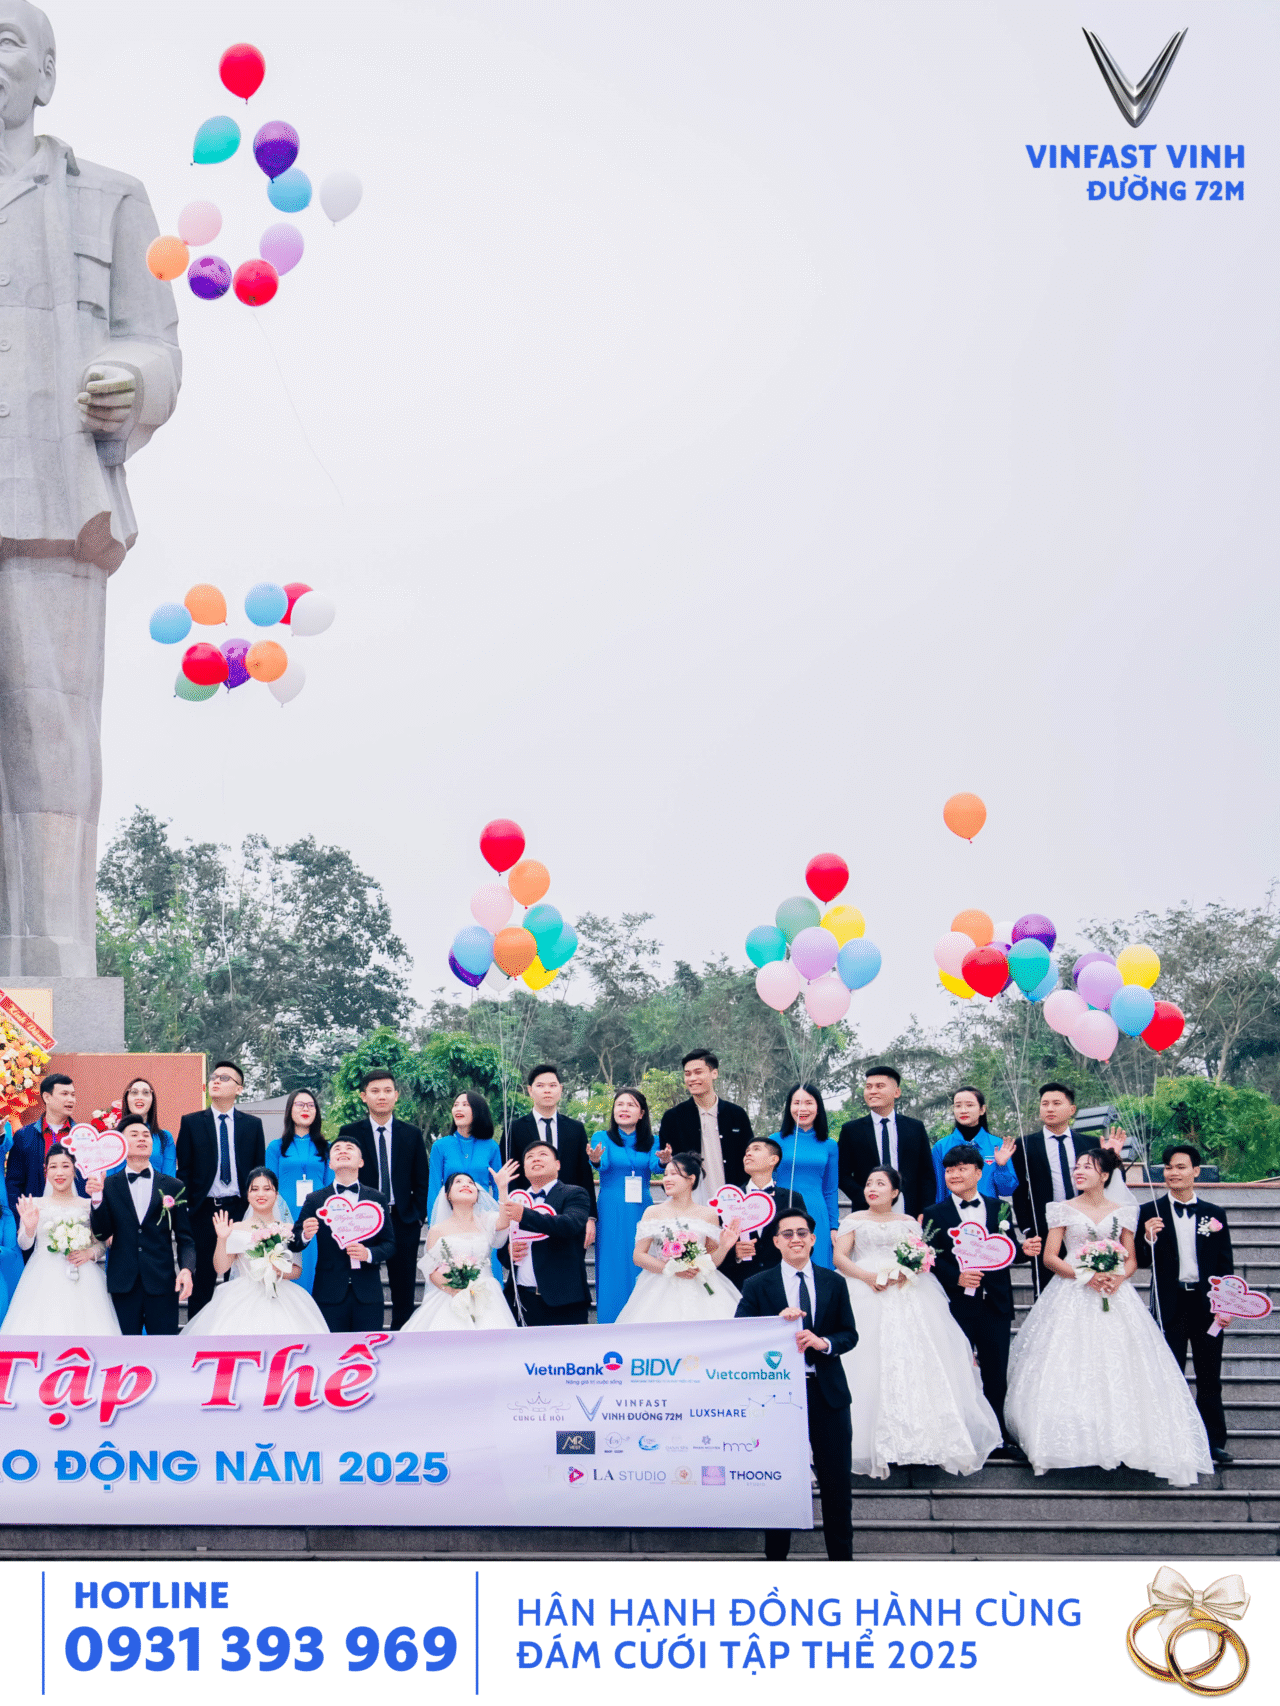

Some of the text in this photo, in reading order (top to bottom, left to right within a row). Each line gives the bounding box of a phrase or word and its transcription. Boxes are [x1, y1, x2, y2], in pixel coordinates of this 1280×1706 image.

[191, 1332, 391, 1408] Thể
[524, 1362, 604, 1376] VietinBank
[631, 1358, 682, 1376] BIDV
[705, 1368, 791, 1380] Vietcombank
[615, 1399, 668, 1407] VINFAST
[601, 1410, 683, 1421] VINH ĐƯỜNG 72M
[689, 1408, 747, 1418] LUXSHARE
[54, 1441, 199, 1491] ĐỘNG
[215, 1442, 321, 1482] NĂM
[338, 1451, 449, 1483] 2025
[593, 1468, 667, 1481] LA STUDIO
[729, 1470, 782, 1480] THOONG
